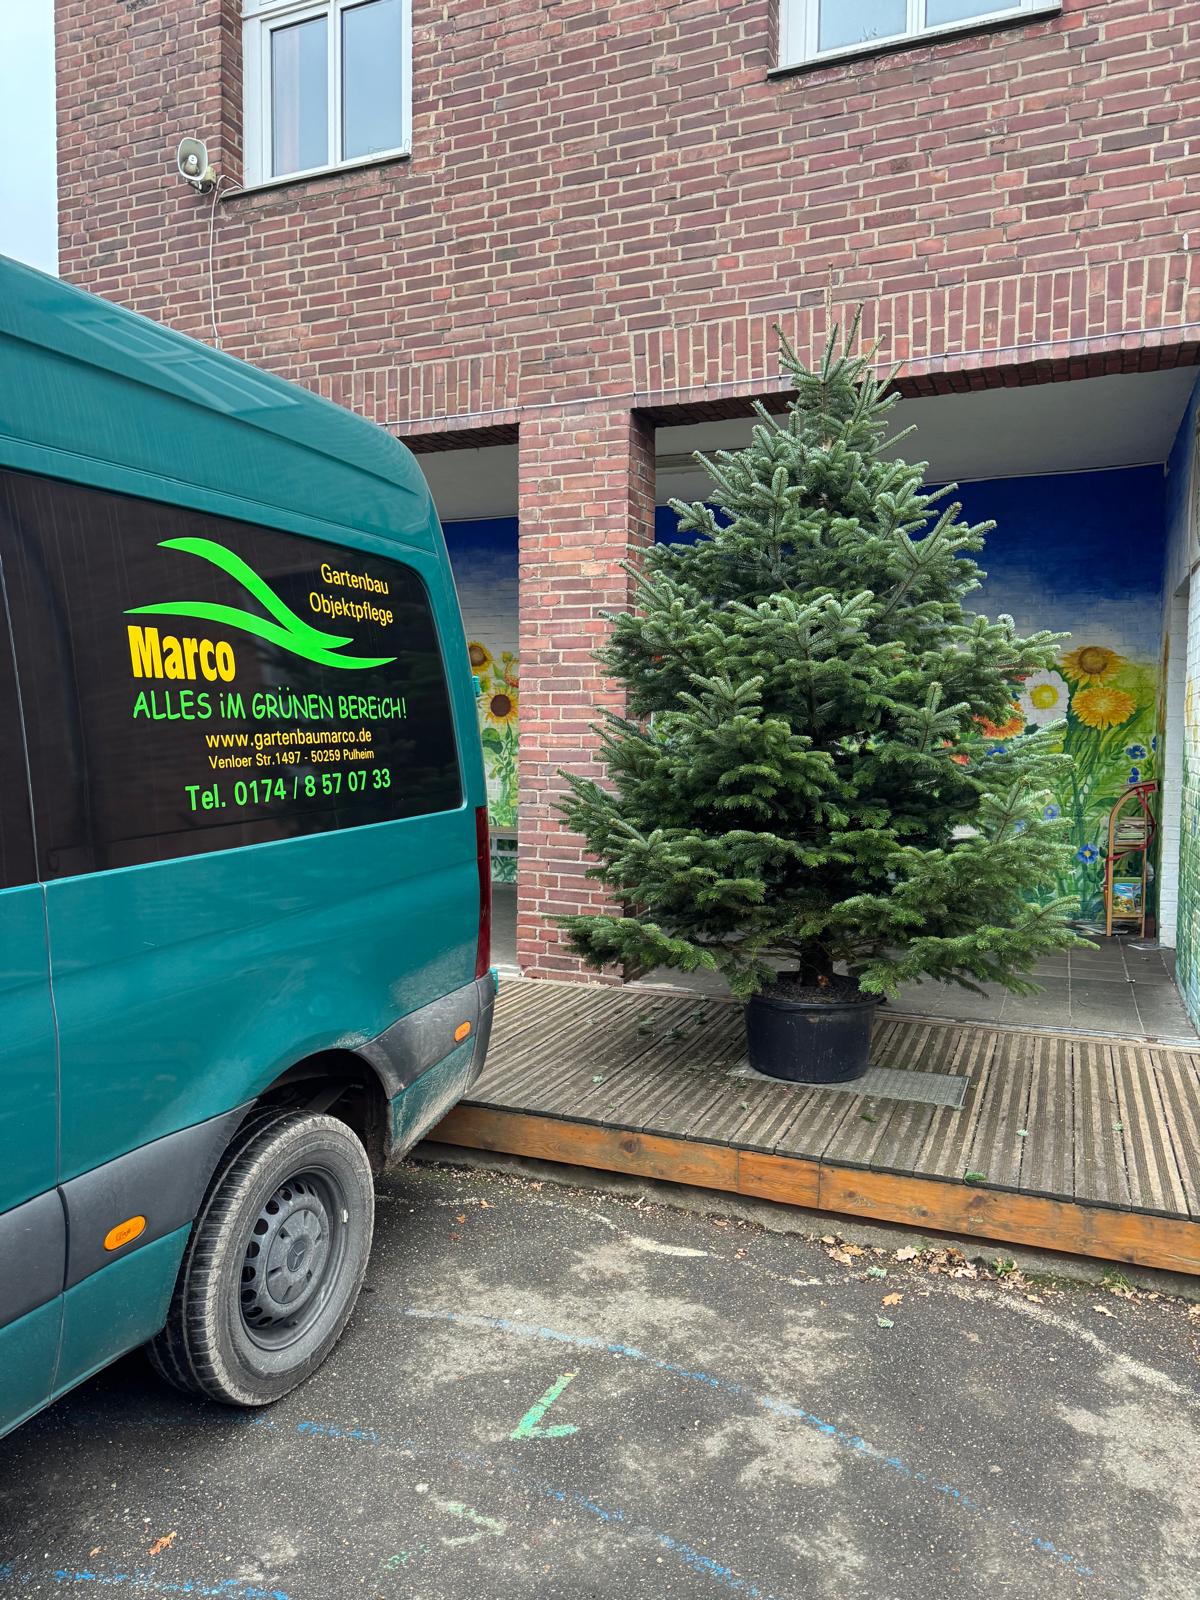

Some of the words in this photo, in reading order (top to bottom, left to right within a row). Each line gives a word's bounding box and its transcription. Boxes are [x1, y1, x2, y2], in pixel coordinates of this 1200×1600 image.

[320, 563, 389, 595] Gartenbau
[309, 591, 394, 627] Objektpflege
[127, 624, 236, 683] Marco
[132, 689, 212, 720] ALLES
[251, 686, 334, 720] GRÜNEN
[205, 727, 373, 750] www.gartenbaumarco.de
[208, 754, 253, 770] Venloer
[311, 748, 341, 763] 50259
[342, 747, 375, 761] Pulheim
[185, 783, 227, 811] Tel.
[233, 777, 288, 806] 0174
[292, 776, 299, 799] /
[304, 774, 316, 797] 8
[321, 772, 342, 795] 57
[347, 769, 367, 792] 07
[372, 767, 391, 788] 33
